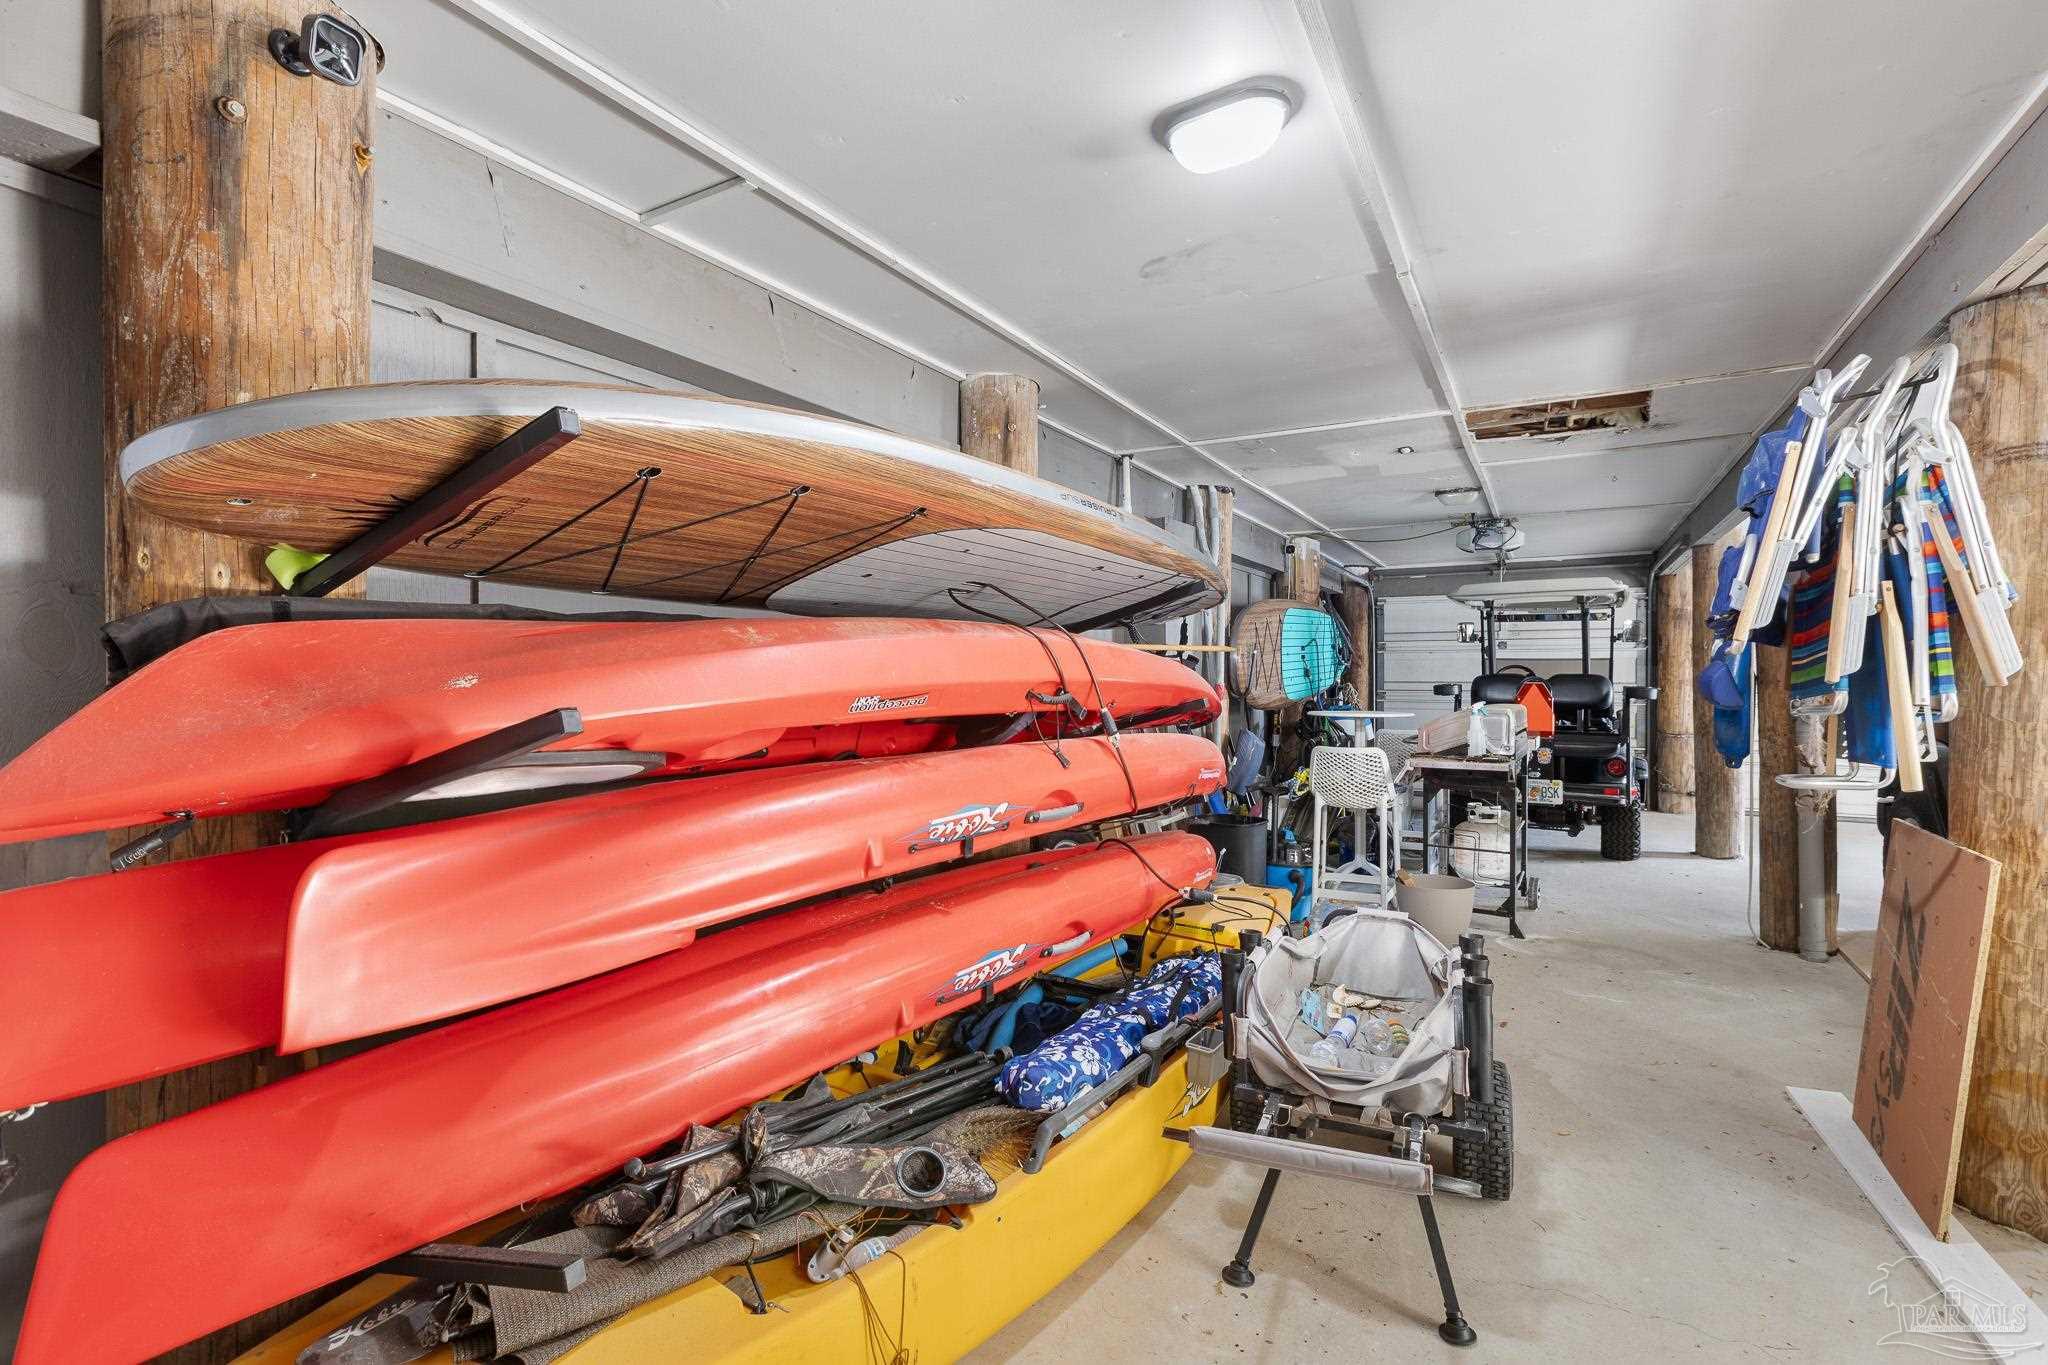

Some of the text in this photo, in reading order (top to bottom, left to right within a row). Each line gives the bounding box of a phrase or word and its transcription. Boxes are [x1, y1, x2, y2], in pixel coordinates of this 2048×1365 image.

[929, 802, 1009, 842] Hobie
[953, 943, 1026, 992] Hobie
[328, 1299, 416, 1351] Hobie
